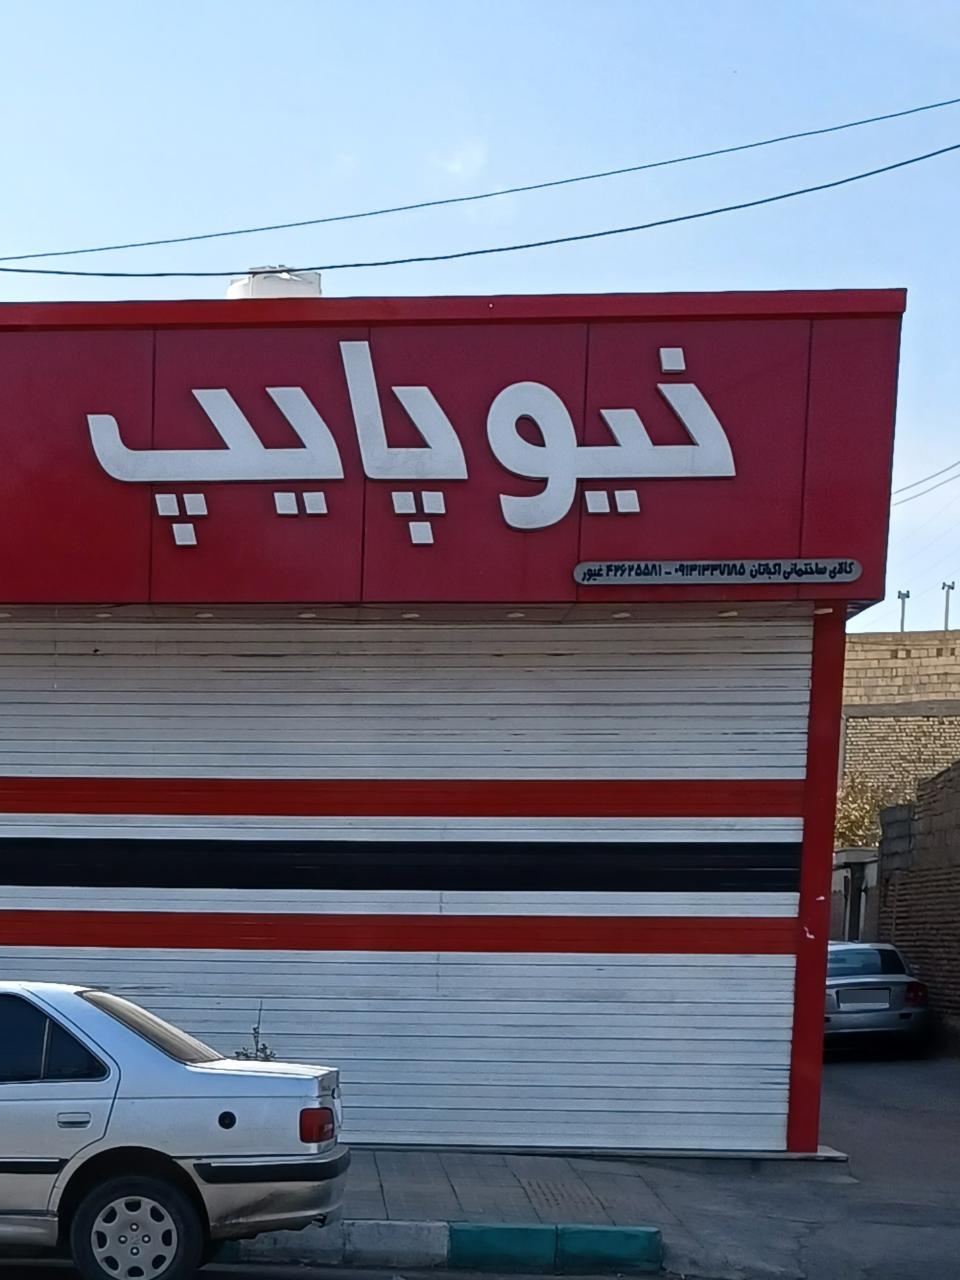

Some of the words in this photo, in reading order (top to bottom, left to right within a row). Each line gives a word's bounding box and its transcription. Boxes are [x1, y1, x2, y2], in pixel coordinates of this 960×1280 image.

[87, 340, 468, 546] پایپ
[486, 347, 736, 530] نیو
[581, 564, 604, 581] غیور
[750, 562, 781, 580] اکباتان
[783, 562, 827, 580] ساختمانی
[829, 561, 854, 579] کالای
